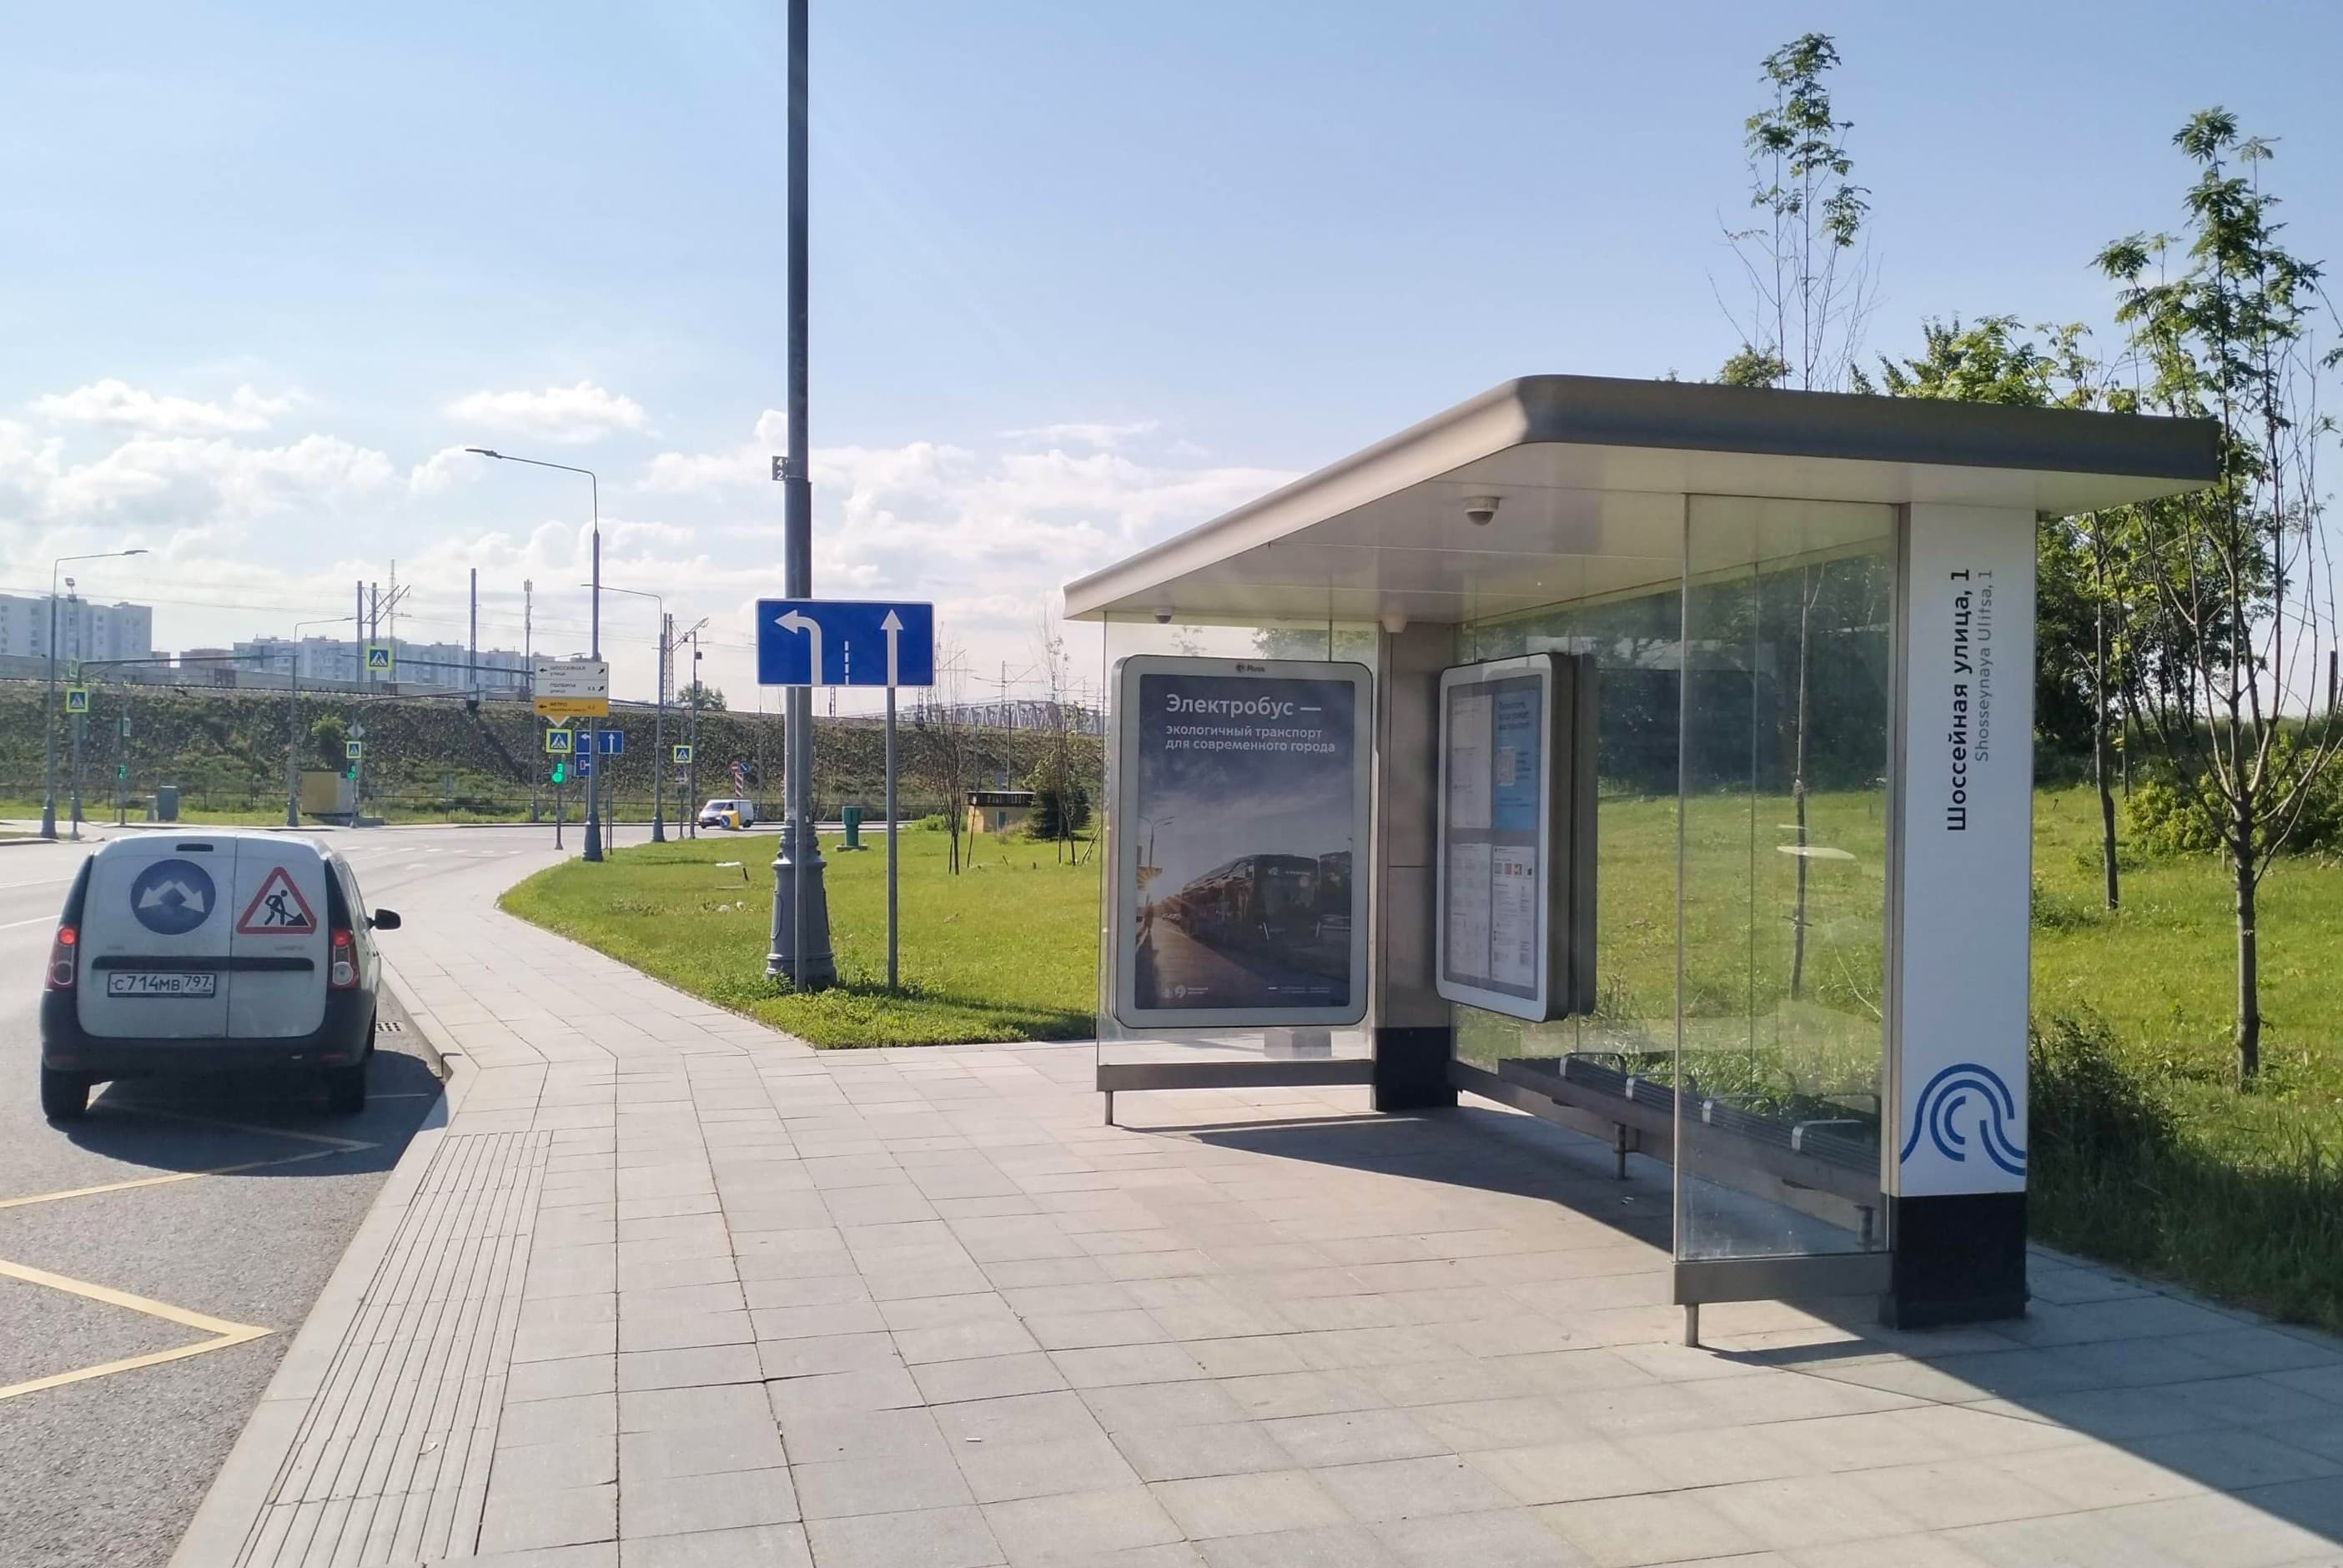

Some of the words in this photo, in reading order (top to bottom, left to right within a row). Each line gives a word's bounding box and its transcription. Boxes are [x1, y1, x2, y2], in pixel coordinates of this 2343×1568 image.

[1950, 569, 1969, 581] 1
[1978, 570, 1992, 579] 1
[1977, 585, 1994, 641] Ulitsa,
[1953, 591, 1973, 674] улица,
[1166, 694, 1294, 720] Электробус
[1975, 647, 1994, 762] Shosseynaya
[1165, 725, 1252, 736] экологичный
[1255, 727, 1322, 739] транспорт
[1165, 739, 1189, 750] для
[1193, 740, 1288, 751] современного
[1290, 741, 1335, 753] города
[1947, 684, 1968, 831] Шоссейная
